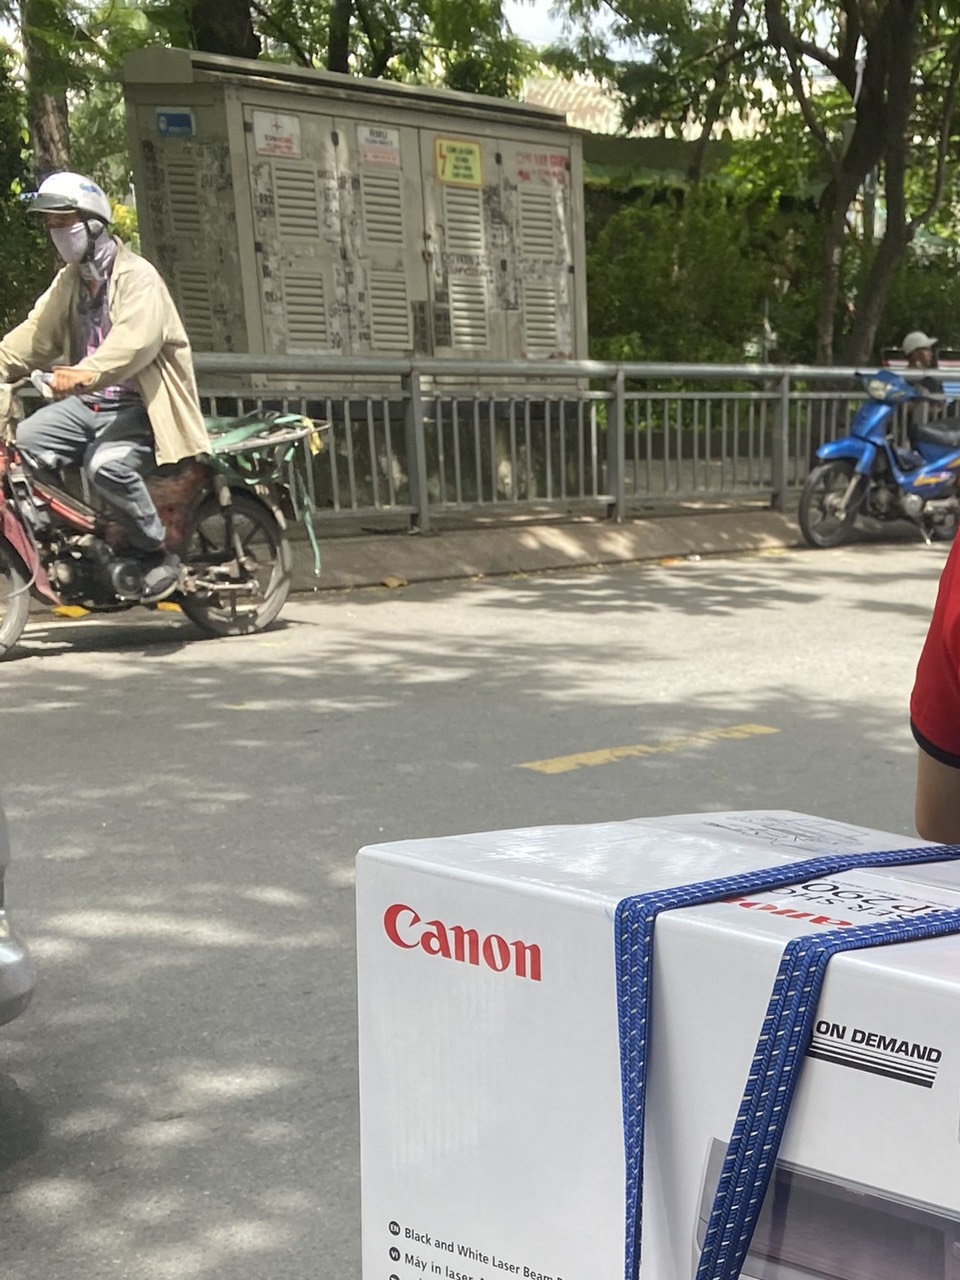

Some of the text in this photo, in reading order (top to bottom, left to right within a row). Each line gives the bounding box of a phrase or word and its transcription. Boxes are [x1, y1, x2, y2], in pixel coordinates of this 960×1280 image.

[383, 903, 542, 982] Canon
[816, 1020, 942, 1064] ON DEMAND
[404, 1227, 432, 1246] Black
[434, 1239, 454, 1253] and
[457, 1244, 489, 1264] White
[492, 1256, 520, 1275] Laser
[404, 1253, 428, 1272] Máy
[431, 1261, 441, 1275] in
